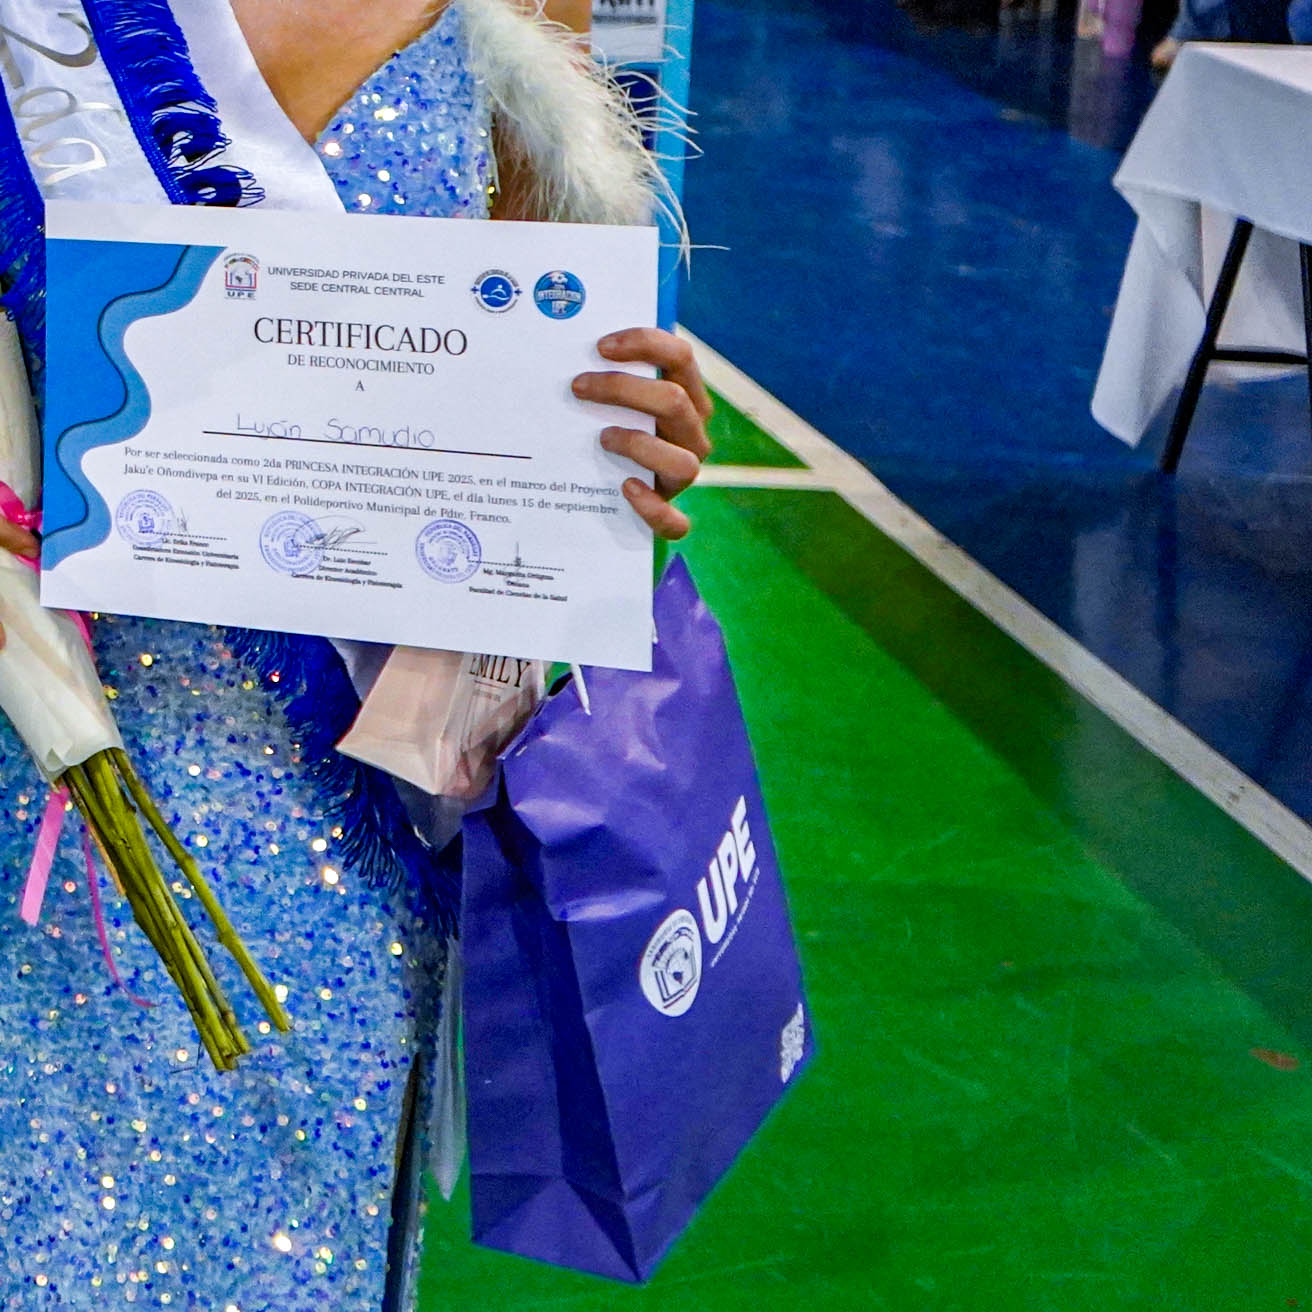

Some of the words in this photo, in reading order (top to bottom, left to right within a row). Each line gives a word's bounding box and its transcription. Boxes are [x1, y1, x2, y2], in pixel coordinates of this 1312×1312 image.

[267, 267, 339, 278] UNIVERSIDAD
[342, 270, 389, 280] PRIVADA
[392, 273, 413, 282] DEL
[416, 274, 444, 284] ESTE
[226, 291, 257, 300] UPE
[290, 281, 318, 291] SEDE
[321, 283, 370, 294] CENTRAL
[374, 286, 423, 297] CENTRAL
[254, 317, 467, 355] CERTIFICADO
[288, 354, 304, 365] DE
[309, 355, 434, 374] RECONOCIMIENTO
[355, 380, 365, 392] A
[323, 418, 435, 448] Samudio
[697, 794, 757, 945] UPE
